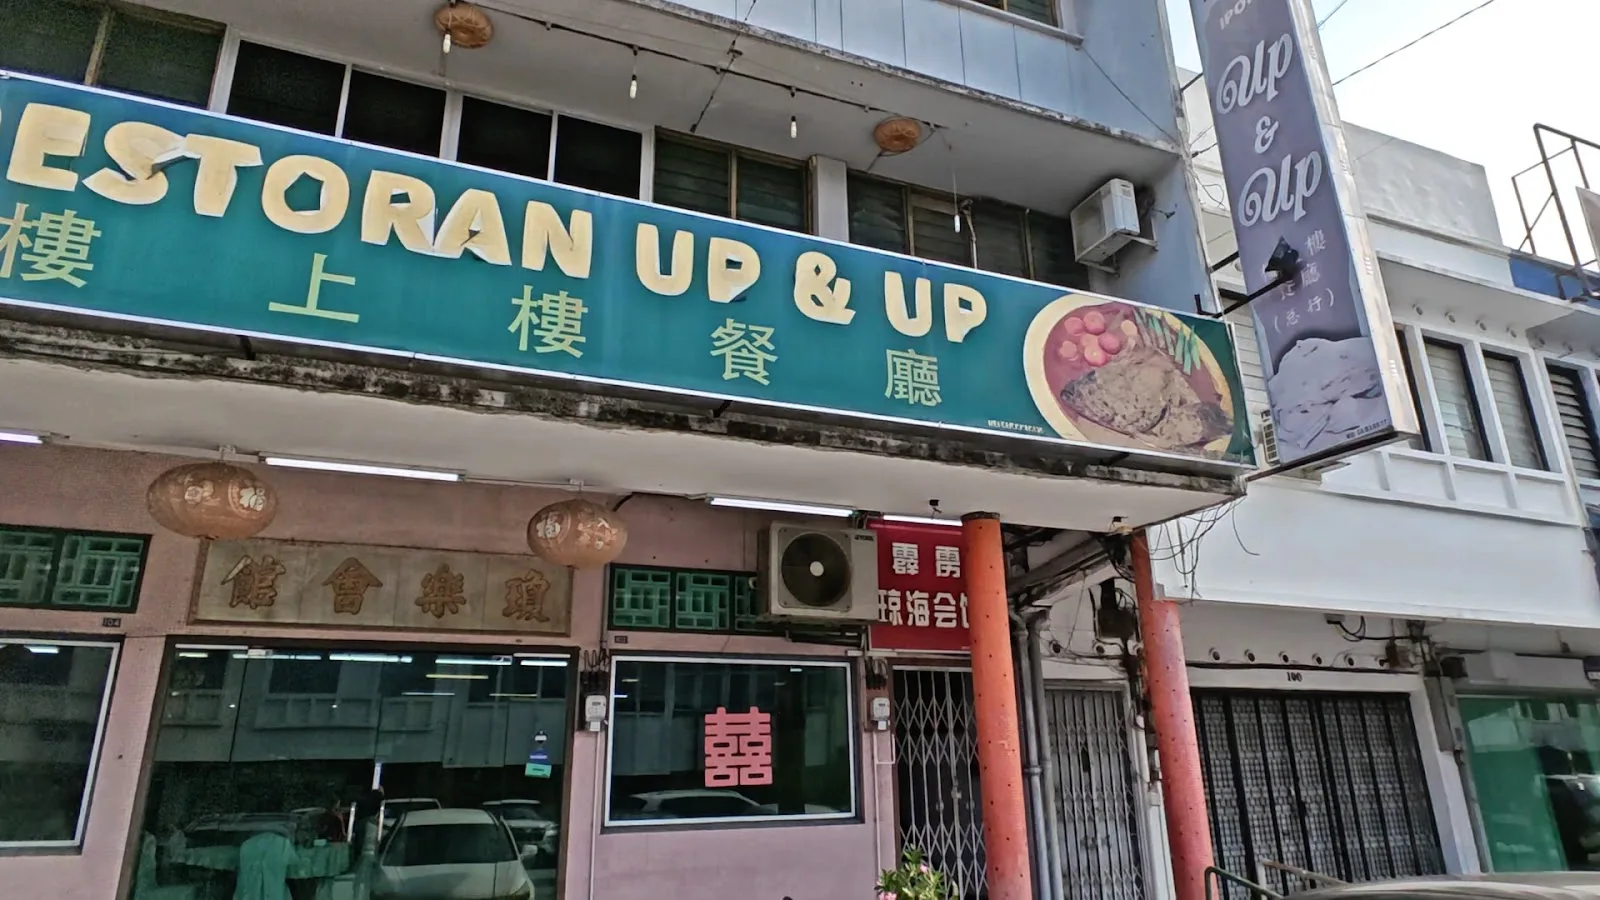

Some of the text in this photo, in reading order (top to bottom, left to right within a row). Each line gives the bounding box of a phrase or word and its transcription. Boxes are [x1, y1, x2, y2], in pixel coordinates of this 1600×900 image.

[1216, 33, 1293, 115] Up
[1254, 116, 1279, 154] &
[0, 103, 988, 344] ESTORAN UP & UP
[1238, 151, 1323, 227] Up
